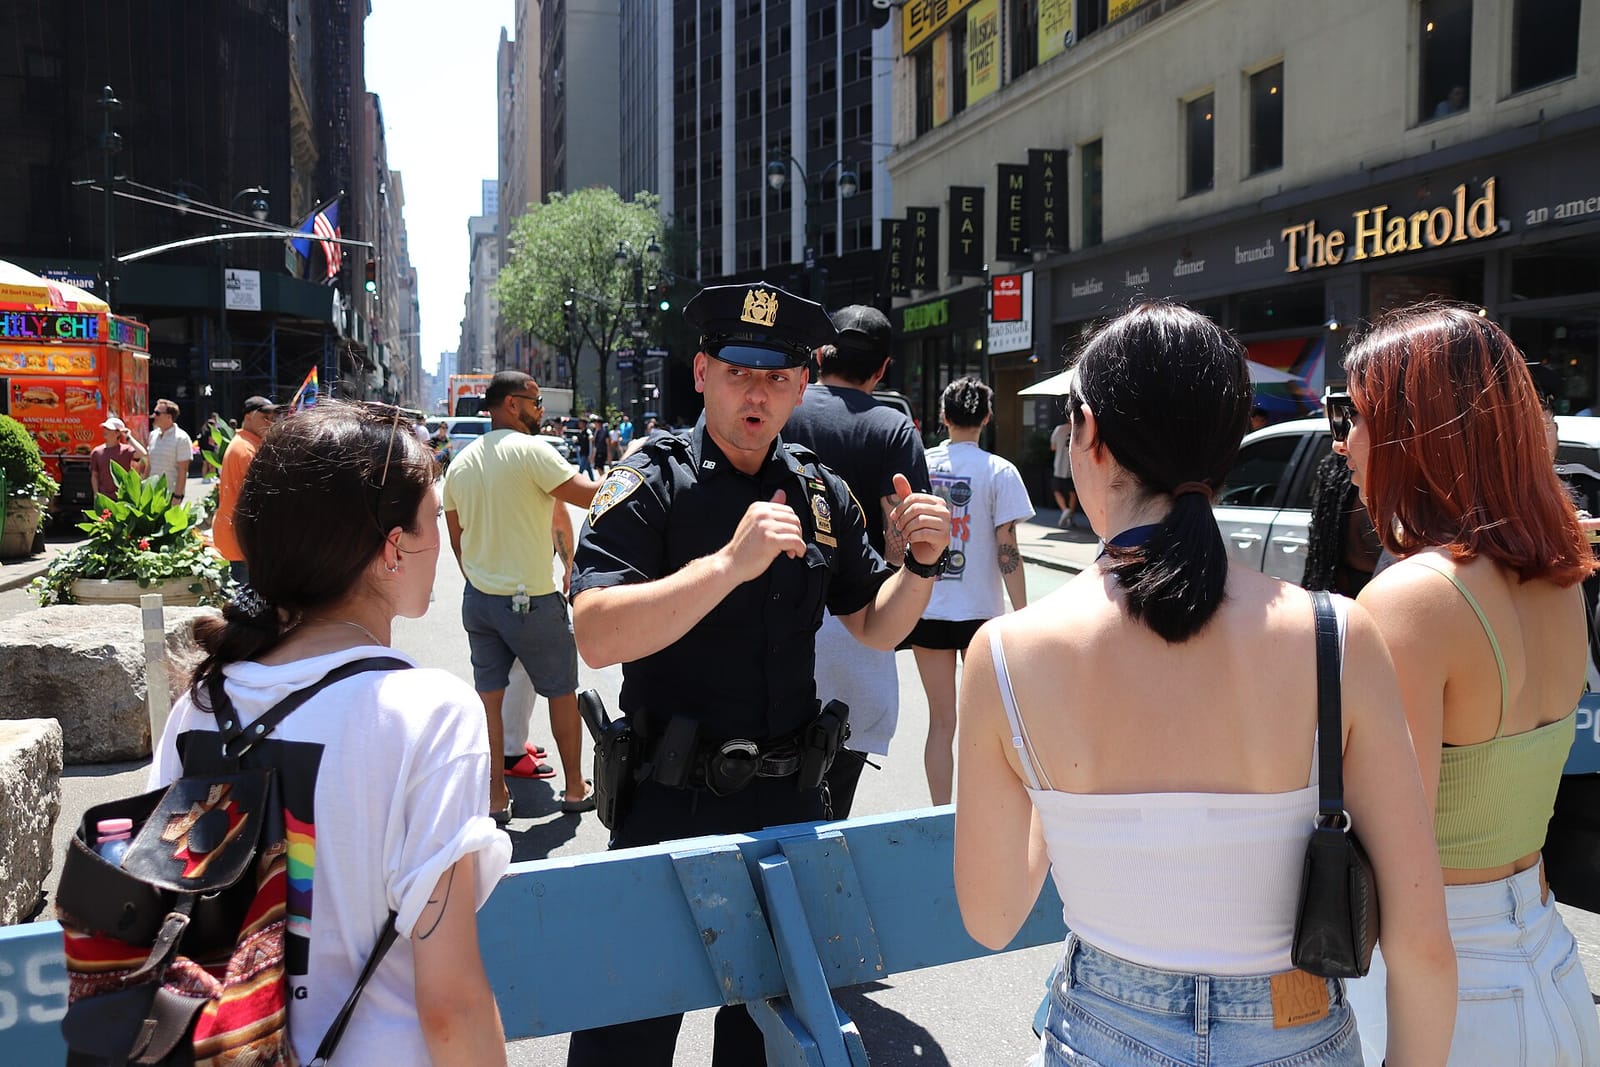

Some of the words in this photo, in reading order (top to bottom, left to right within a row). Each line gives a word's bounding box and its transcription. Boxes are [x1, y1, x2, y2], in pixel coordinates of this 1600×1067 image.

[969, 41, 994, 86] TICKET
[960, 196, 974, 254] EAT
[1009, 174, 1023, 248] MEET
[1280, 218, 1346, 273] The
[1352, 176, 1499, 261] Harold
[1526, 207, 1549, 225] an
[891, 223, 901, 293] FRESH
[915, 211, 927, 286] DRINK
[1126, 266, 1150, 287] lunch
[1174, 258, 1206, 277] dinner
[1235, 239, 1275, 264] brunch
